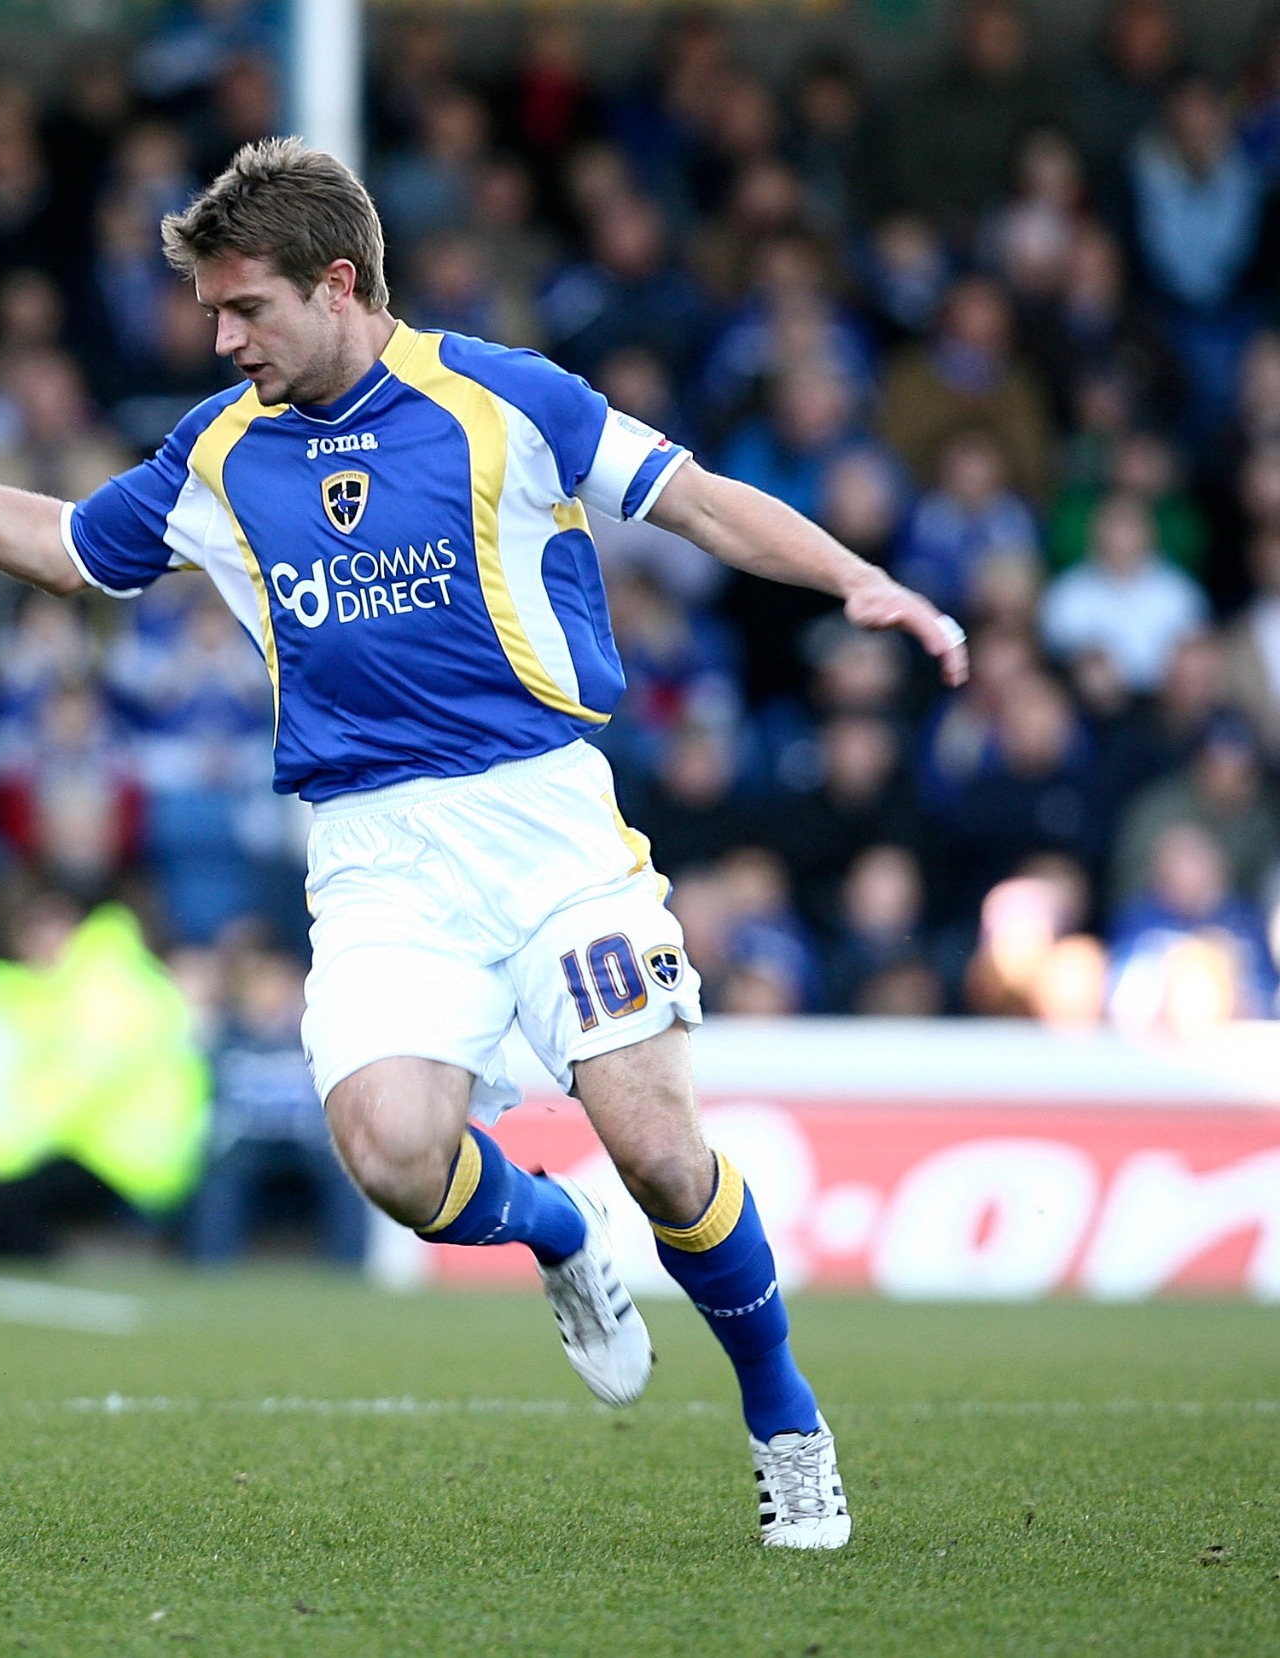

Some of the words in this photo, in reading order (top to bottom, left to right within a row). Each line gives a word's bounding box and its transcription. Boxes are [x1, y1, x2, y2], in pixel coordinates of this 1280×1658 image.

[330, 538, 457, 586] COMMS
[335, 573, 452, 624] DIRECT
[559, 931, 649, 1033] 10
